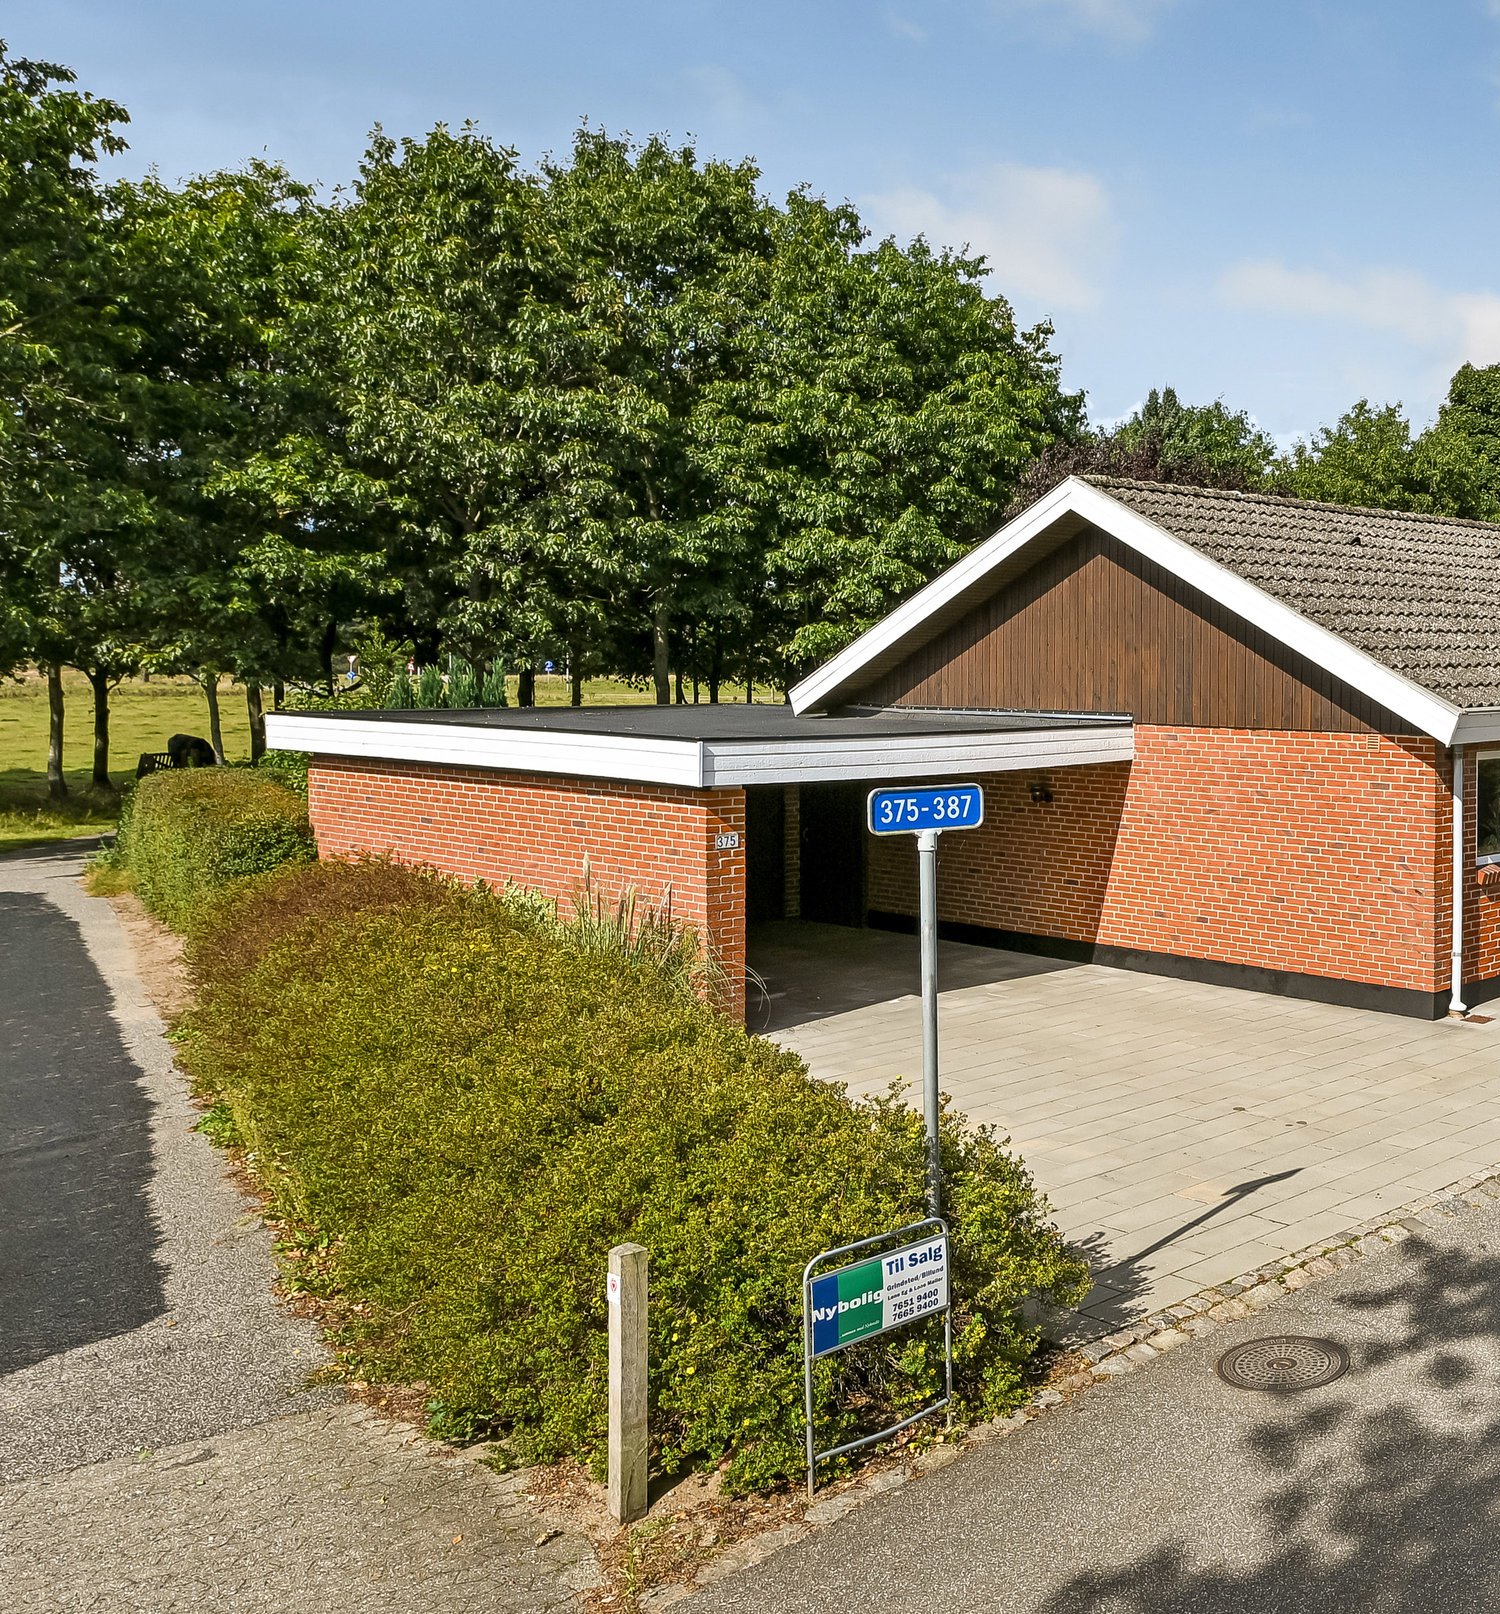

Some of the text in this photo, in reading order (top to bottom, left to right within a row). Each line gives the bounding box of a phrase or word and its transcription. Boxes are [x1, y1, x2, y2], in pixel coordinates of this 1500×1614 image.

[880, 795, 972, 824] 375-387
[717, 835, 736, 848] 375
[886, 1244, 943, 1276] Til Salg
[812, 1289, 884, 1323] Nybolig
[892, 1288, 939, 1312] 7651 9400
[892, 1297, 939, 1322] 7665 9400
